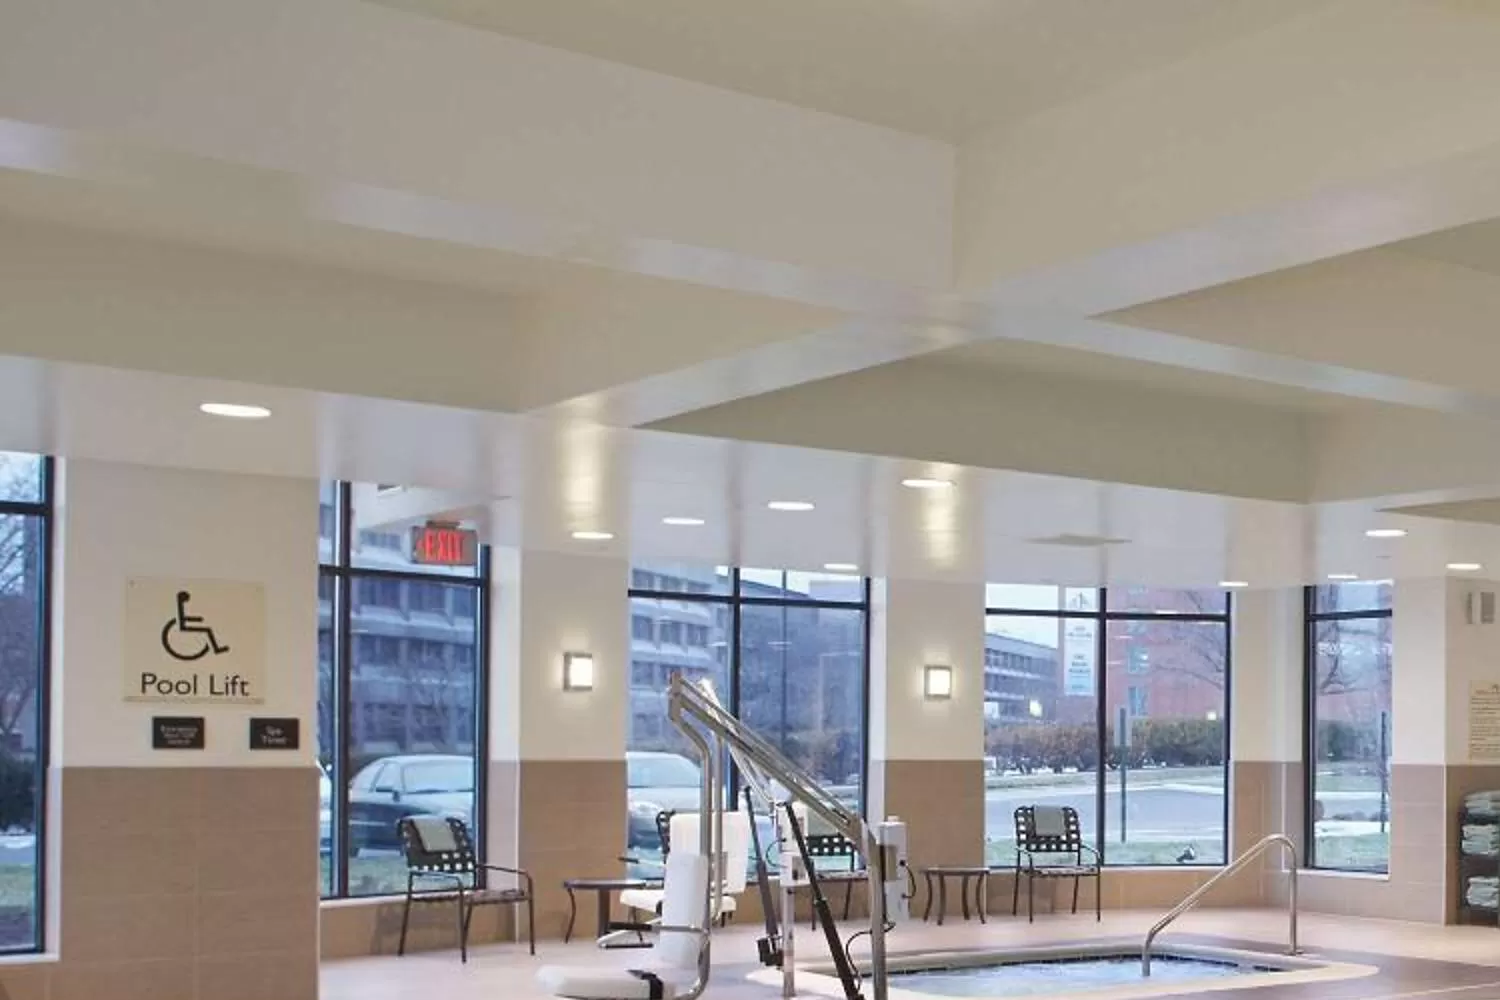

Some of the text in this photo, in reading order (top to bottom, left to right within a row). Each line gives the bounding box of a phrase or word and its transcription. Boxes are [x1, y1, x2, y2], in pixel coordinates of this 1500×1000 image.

[424, 529, 468, 562] EXIT
[141, 672, 250, 696] Pool Lift
